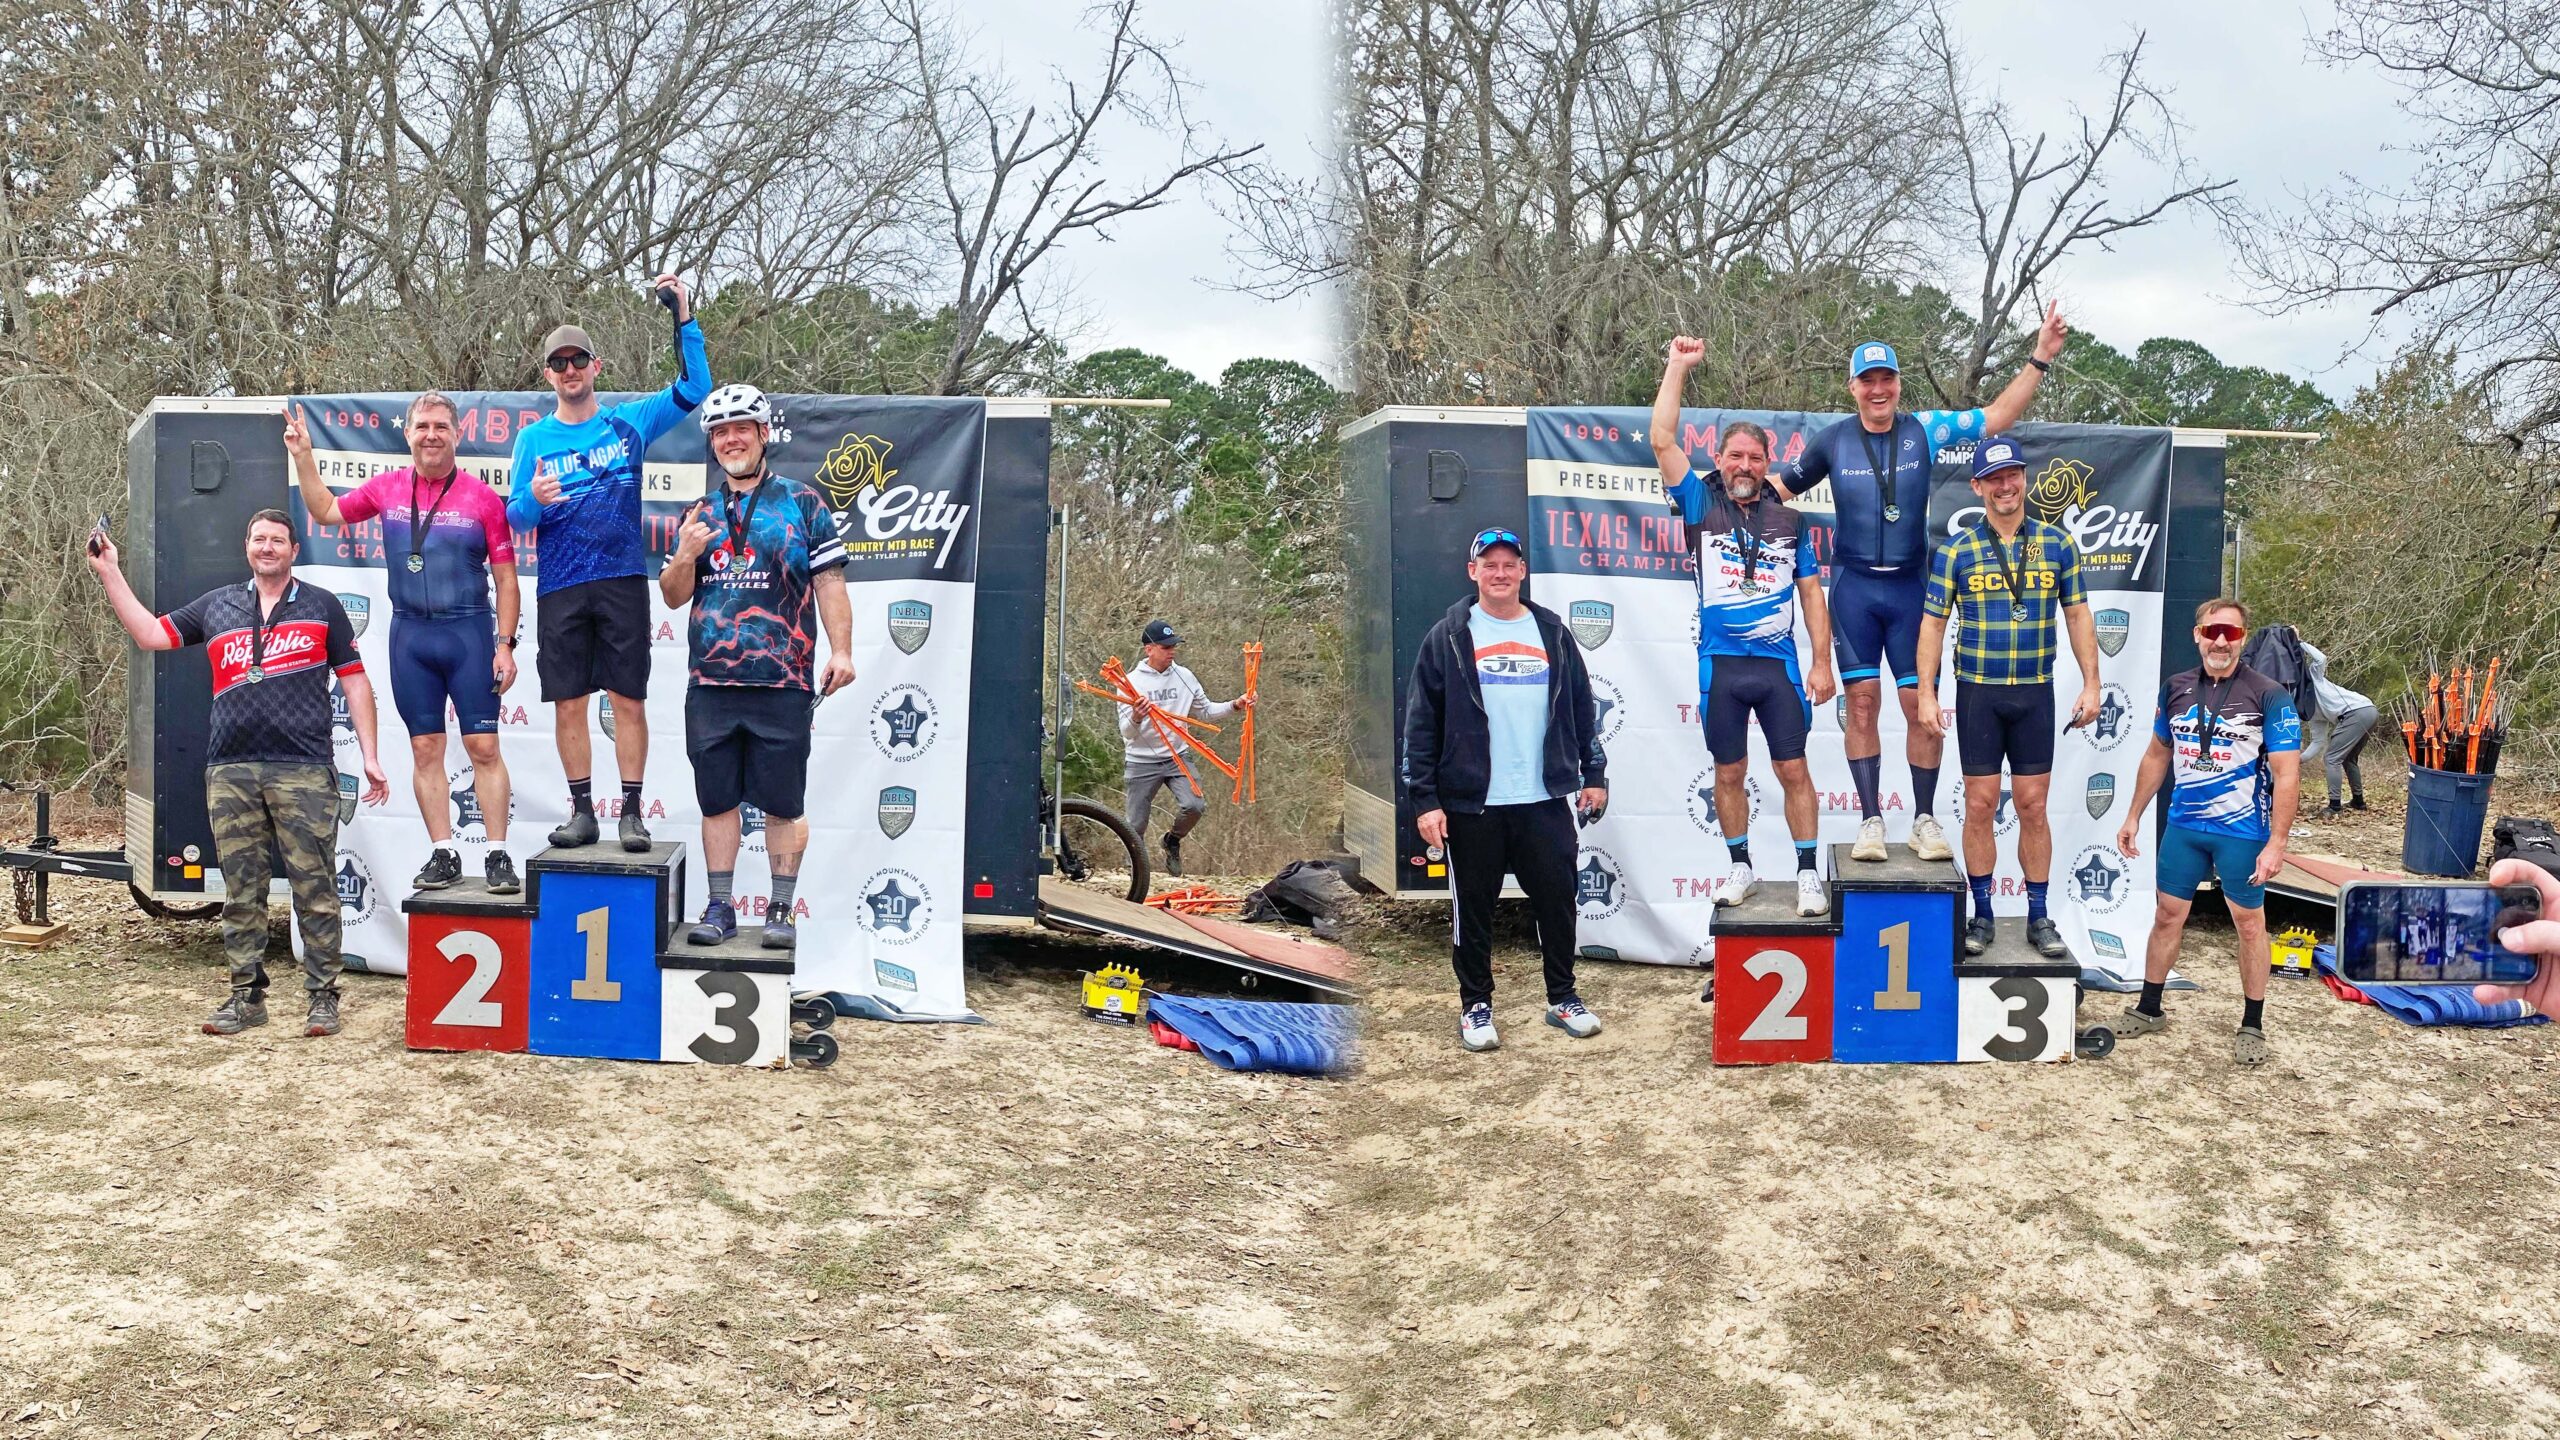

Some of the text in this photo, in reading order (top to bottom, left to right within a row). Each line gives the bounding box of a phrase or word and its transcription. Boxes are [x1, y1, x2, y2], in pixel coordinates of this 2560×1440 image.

[324, 411, 381, 429] 1996
[1563, 424, 1621, 442] 1996
[545, 437, 630, 477] BLUE AGAVE
[857, 484, 971, 569] City
[1546, 510, 1629, 550] TEXAS
[874, 552, 898, 560] TYLER
[887, 539, 907, 551] MTB
[910, 538, 935, 550] RACE
[2062, 503, 2159, 581] City
[2091, 555, 2107, 565] MTB
[2111, 554, 2133, 565] RACE
[722, 581, 771, 590] CYCLES
[895, 607, 926, 617] NBLS
[1576, 606, 1608, 616] NBLS
[2100, 615, 2126, 624] NBLS
[871, 683, 939, 716] TEXAS MOUNTAIN BIKE
[1612, 687, 1625, 705] BIKE
[2123, 694, 2133, 709] BIKE
[870, 729, 936, 763] RACING ASSOCIATION
[2099, 723, 2132, 752] ASSOCIATION
[2178, 746, 2232, 761] GASAS
[1687, 770, 1706, 793] TEXAS
[1747, 776, 1761, 794] BIKE
[884, 793, 910, 803] NBLS
[1687, 807, 1710, 834] RACING
[1579, 846, 1624, 879] MOUNTAIN BIKE
[2083, 844, 2119, 857] MOUNTAIN
[2118, 857, 2130, 873] BIKE
[363, 864, 373, 882] BIKE
[858, 867, 932, 902] TEXAS MOUNTAIN BIKE
[1584, 892, 1627, 921] ASSOCIATION
[2089, 887, 2130, 915] ASSOCIATION
[881, 917, 931, 946] ASSOCIATION
[571, 906, 621, 1001] 1
[1689, 946, 1702, 965] TEXAS
[1874, 921, 1921, 1010] 1
[432, 930, 502, 1028] 2
[1739, 950, 1807, 1040] 2
[688, 970, 760, 1065] 3
[1983, 977, 2049, 1062] 3
